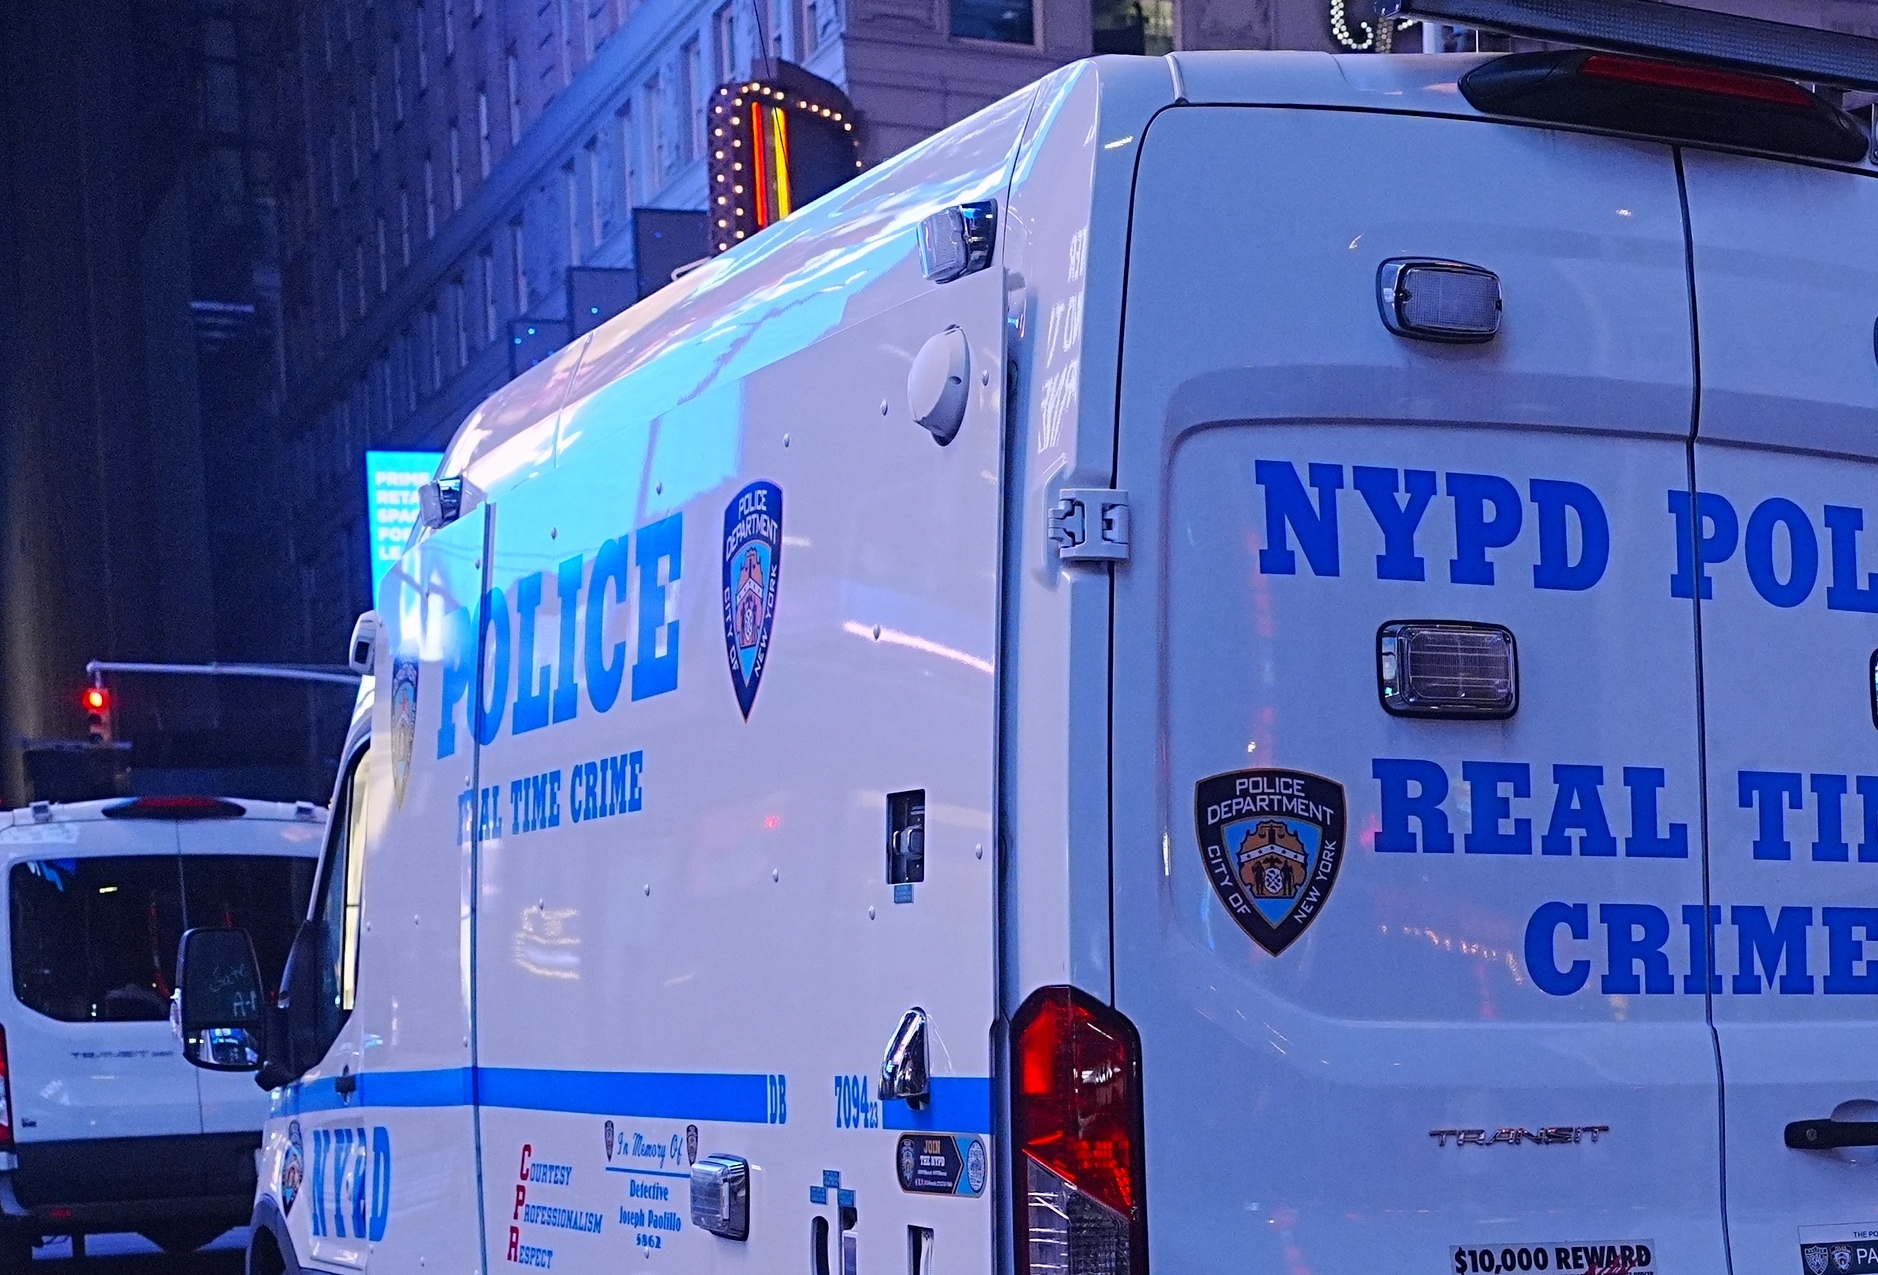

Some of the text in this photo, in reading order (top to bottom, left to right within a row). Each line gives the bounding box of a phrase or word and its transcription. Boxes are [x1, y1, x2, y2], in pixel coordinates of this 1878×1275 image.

[375, 471, 430, 486] PRIME
[738, 490, 767, 520] POLICE
[1254, 459, 1610, 591] NYPD
[726, 514, 778, 561] DEPARTMENT
[437, 512, 683, 760] POLICE
[724, 586, 739, 672] CITY OF
[754, 563, 778, 678] NEW YORK
[510, 770, 561, 835] TIME
[570, 750, 643, 824] CRIME
[1207, 795, 1334, 826] DEPARTMENT
[1236, 777, 1305, 796] POLICE
[1371, 758, 1688, 859] REAL
[1208, 845, 1251, 916] CITY OF
[1293, 840, 1337, 924] NEW YORK
[769, 1074, 787, 1125] DB
[834, 1075, 869, 1129] 7094
[617, 1132, 683, 1168] In Memory Of
[1428, 1125, 1609, 1148] TRANSIT
[312, 1126, 391, 1242] NYPD
[629, 1179, 669, 1201] Detective
[619, 1206, 682, 1232] Joseph Paolillo
[1455, 1246, 1549, 1275] $10,000
[1555, 1244, 1652, 1270] REWARD
